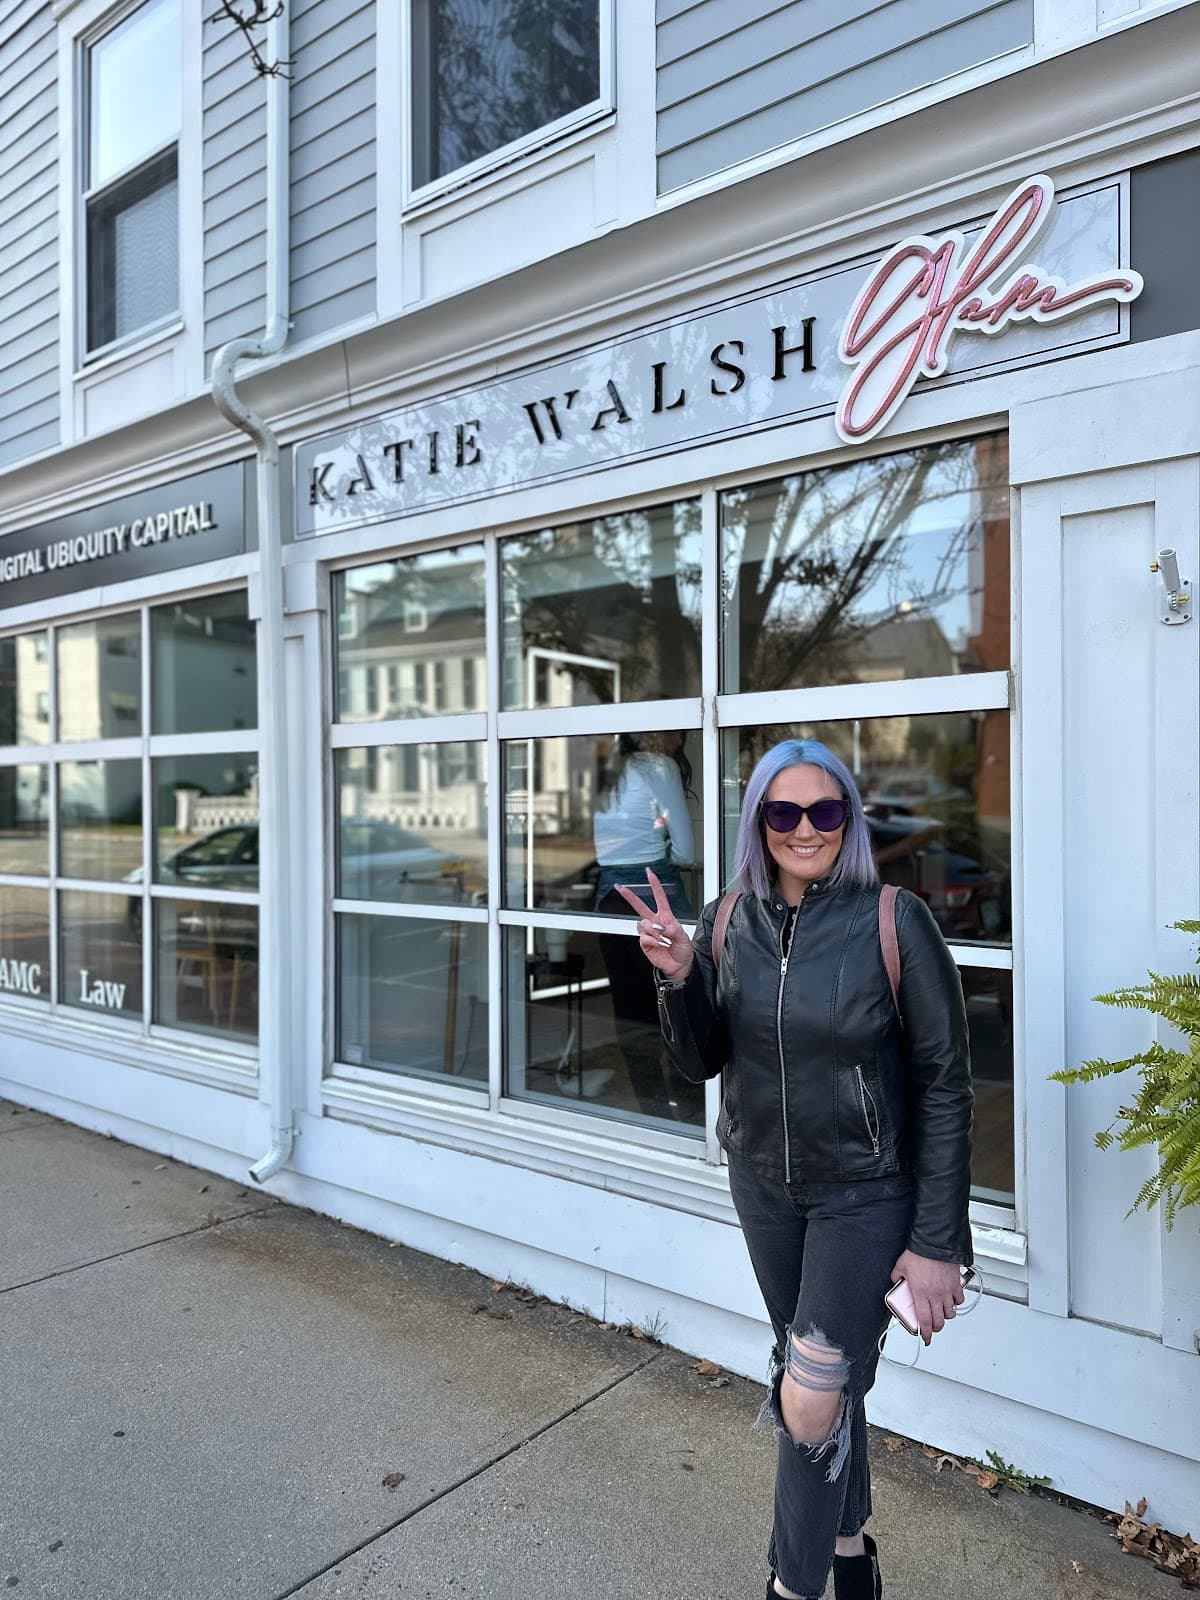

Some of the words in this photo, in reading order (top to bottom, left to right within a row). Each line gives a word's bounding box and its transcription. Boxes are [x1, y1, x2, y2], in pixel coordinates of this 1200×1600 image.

[308, 420, 481, 505] KATIE
[522, 317, 816, 445] WALSH
[0, 549, 44, 582] IGITAL
[47, 524, 126, 570] UBIQUITY
[130, 501, 213, 547] CAPITAL
[79, 970, 126, 1009] Law
